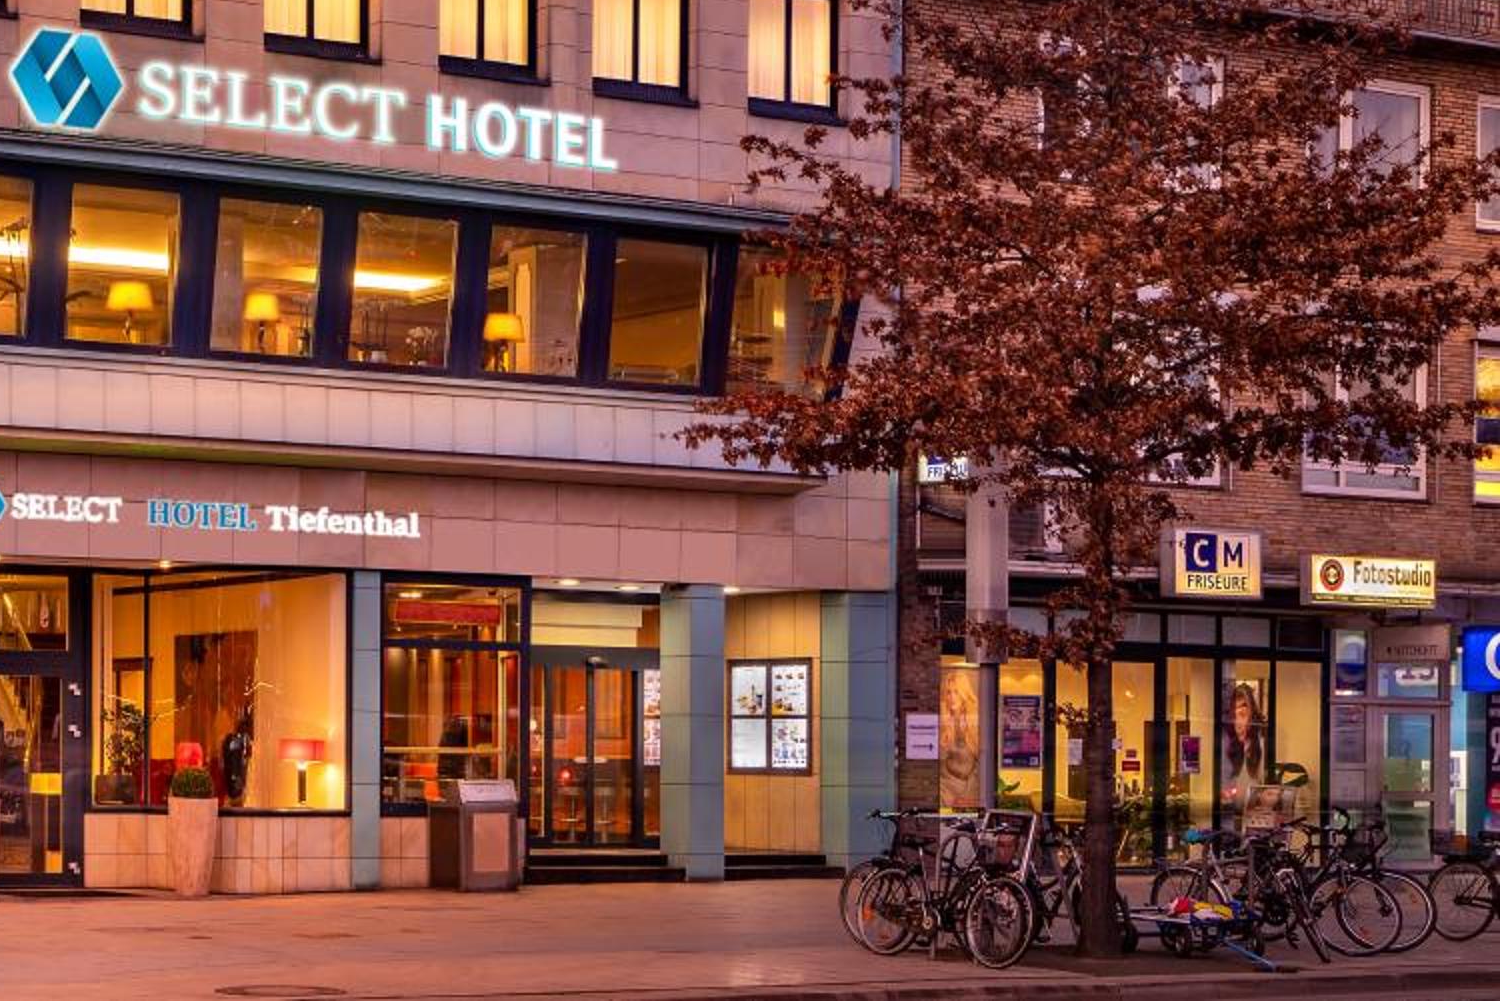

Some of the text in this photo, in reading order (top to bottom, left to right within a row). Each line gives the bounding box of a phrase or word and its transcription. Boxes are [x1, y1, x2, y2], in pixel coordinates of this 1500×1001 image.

[138, 61, 618, 170] SELECT HOTEL
[11, 493, 421, 538] SELECT HOTEL Tiefenthal
[1187, 574, 1249, 590] FRISEURE
[1352, 560, 1431, 587] Fotostudio
